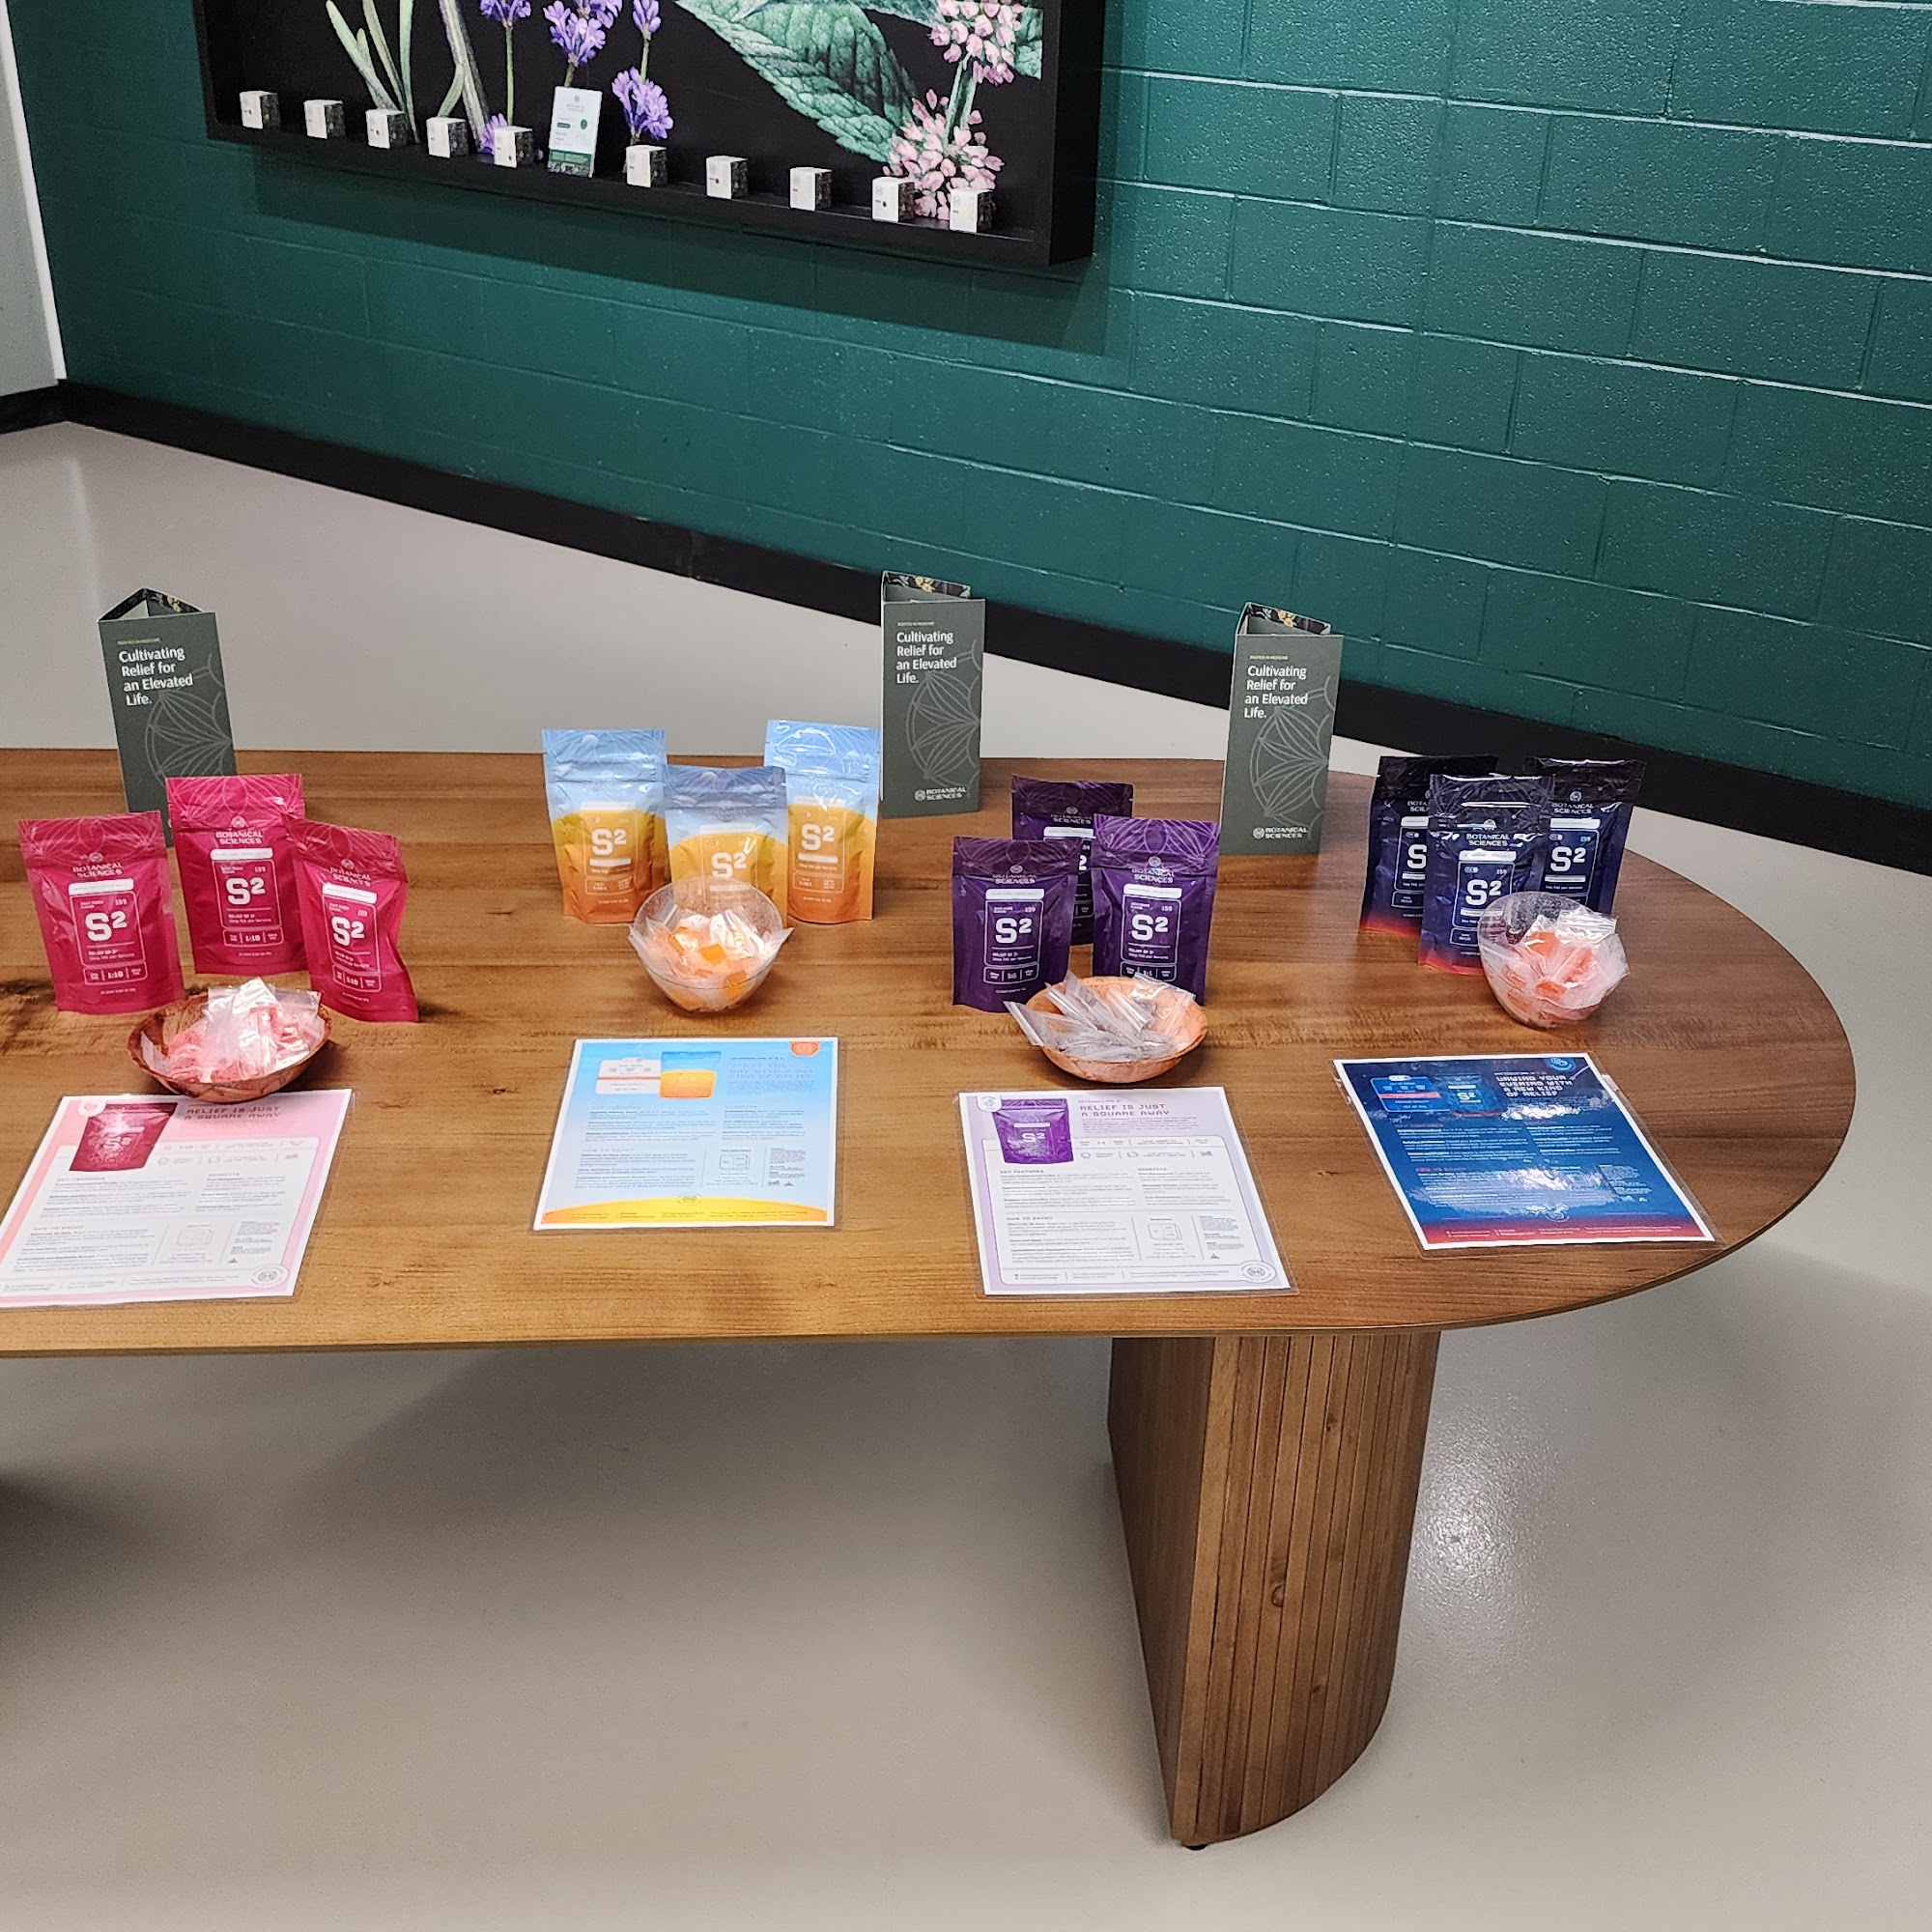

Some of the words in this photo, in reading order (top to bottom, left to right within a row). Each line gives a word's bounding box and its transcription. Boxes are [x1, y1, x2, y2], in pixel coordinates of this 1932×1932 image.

[896, 631, 954, 644] Cultivating
[118, 647, 185, 663] Cultivating
[896, 644, 927, 657] Relief
[928, 644, 944, 656] for
[121, 663, 156, 677] Relief
[157, 662, 176, 674] for
[895, 660, 910, 670] an
[912, 656, 957, 670] Elevated
[896, 671, 919, 684] Life.
[1247, 665, 1307, 680] Cultivating
[123, 681, 140, 693] an
[142, 673, 193, 691] Elevated
[1246, 679, 1278, 691] Relief
[1280, 679, 1296, 691] for
[126, 693, 152, 706] Life.
[1244, 694, 1259, 704] an
[1262, 693, 1309, 705] Elevated
[1244, 707, 1267, 719] Life.
[926, 786, 967, 795] BOTANICAL
[926, 792, 963, 801] SCIENCES
[215, 831, 264, 839] BOTANICAL
[72, 863, 123, 874] BOTANICAL
[1133, 873, 1174, 884] SCIENCES
